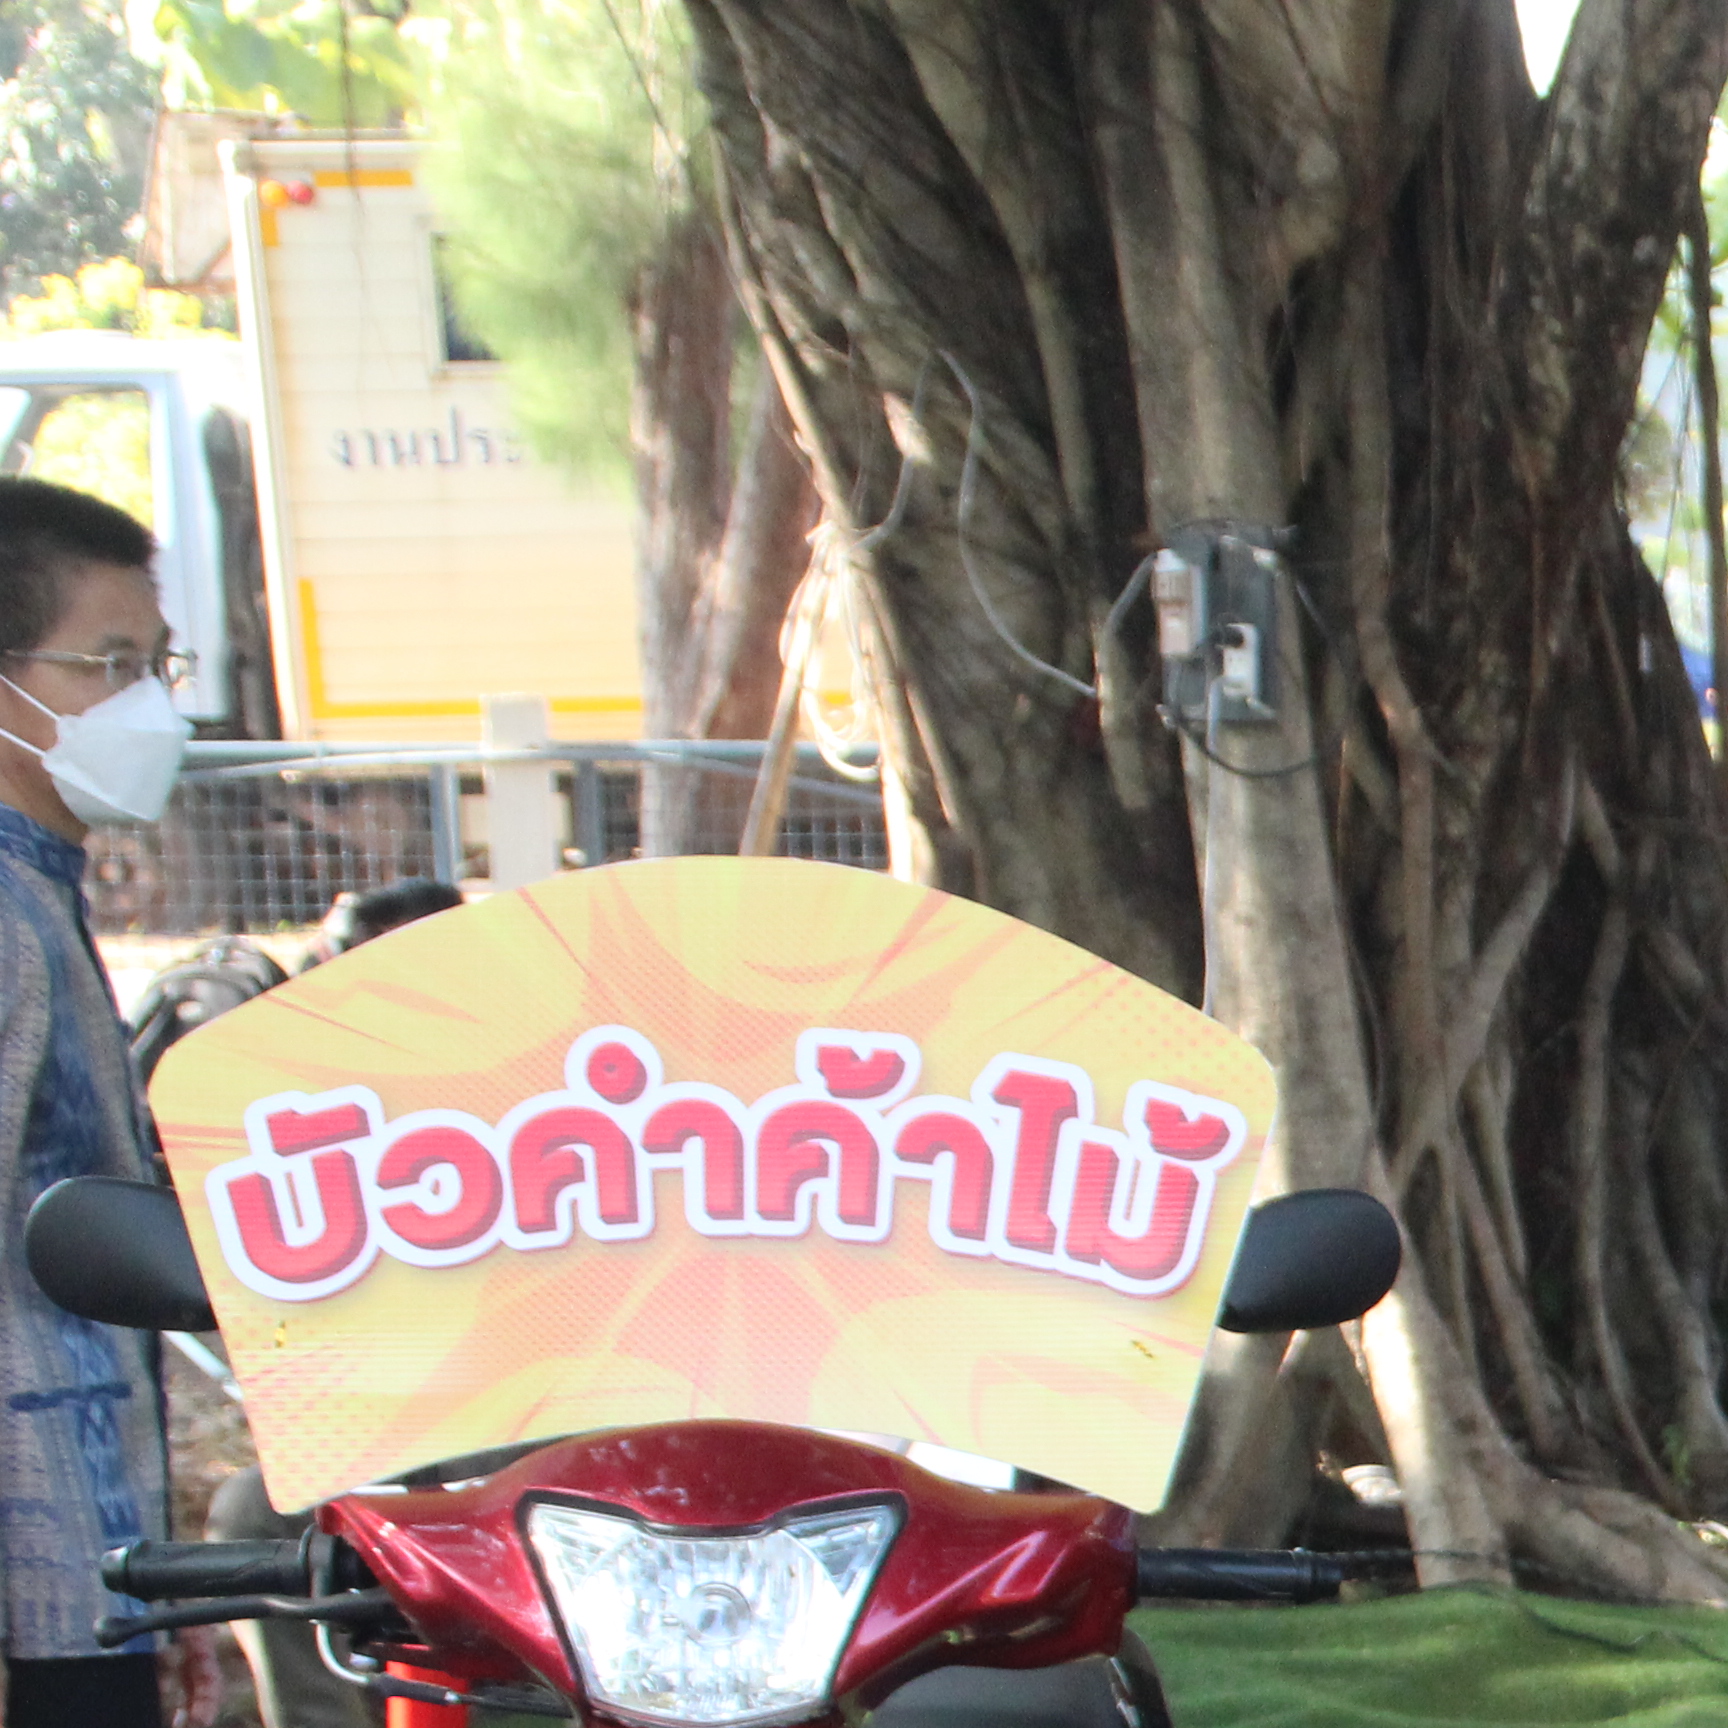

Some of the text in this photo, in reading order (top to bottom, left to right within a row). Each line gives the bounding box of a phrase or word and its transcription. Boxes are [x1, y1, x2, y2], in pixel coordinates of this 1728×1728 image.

[228, 1038, 1230, 1285] บัวคำค้าไม้
